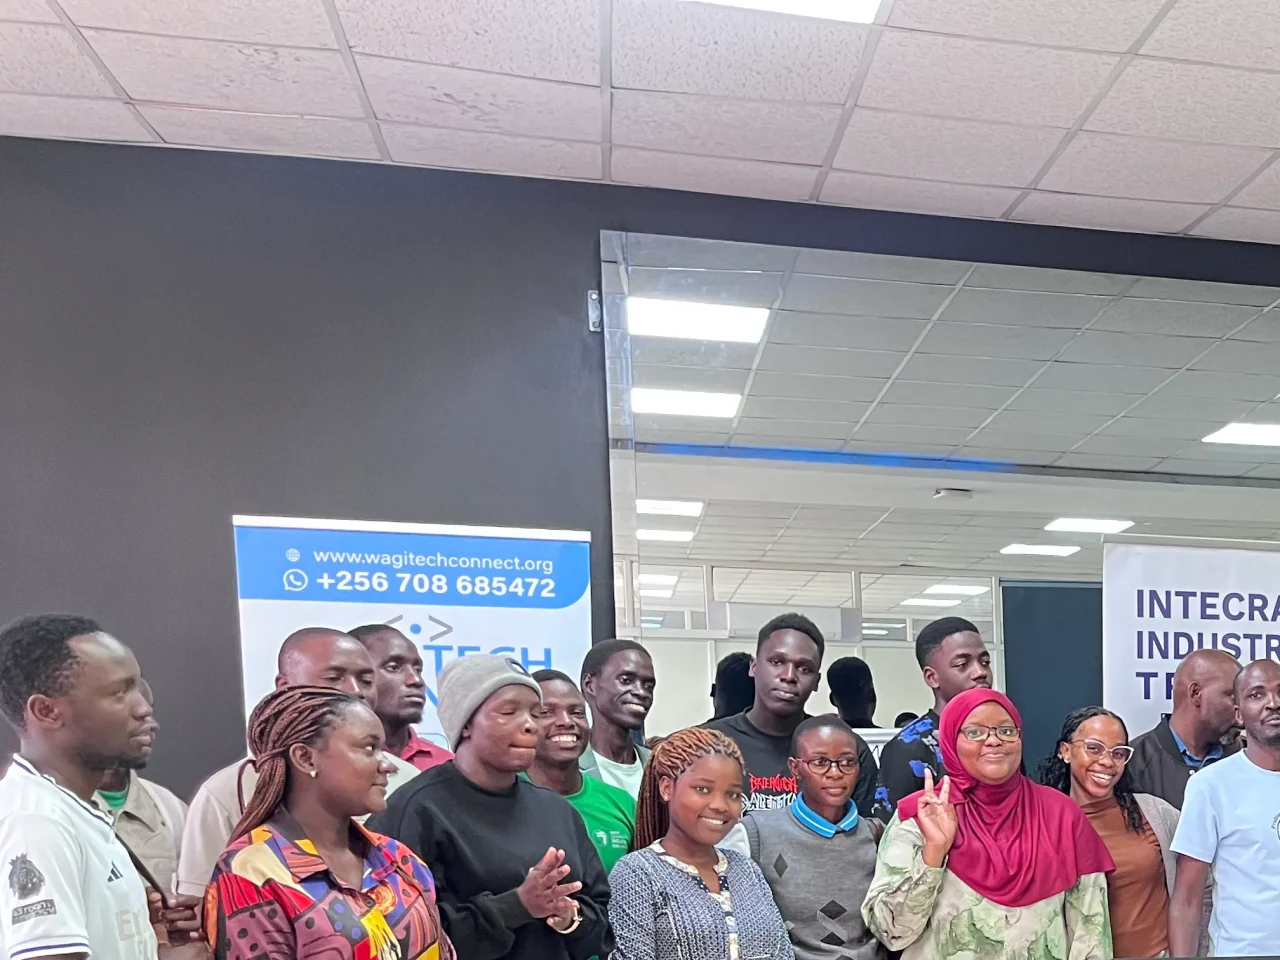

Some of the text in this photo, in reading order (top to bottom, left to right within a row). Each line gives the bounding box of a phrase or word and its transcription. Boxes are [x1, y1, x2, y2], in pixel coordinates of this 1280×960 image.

[314, 551, 553, 575] www.wagitechconnect.org
[316, 571, 556, 597] +256 708 685472
